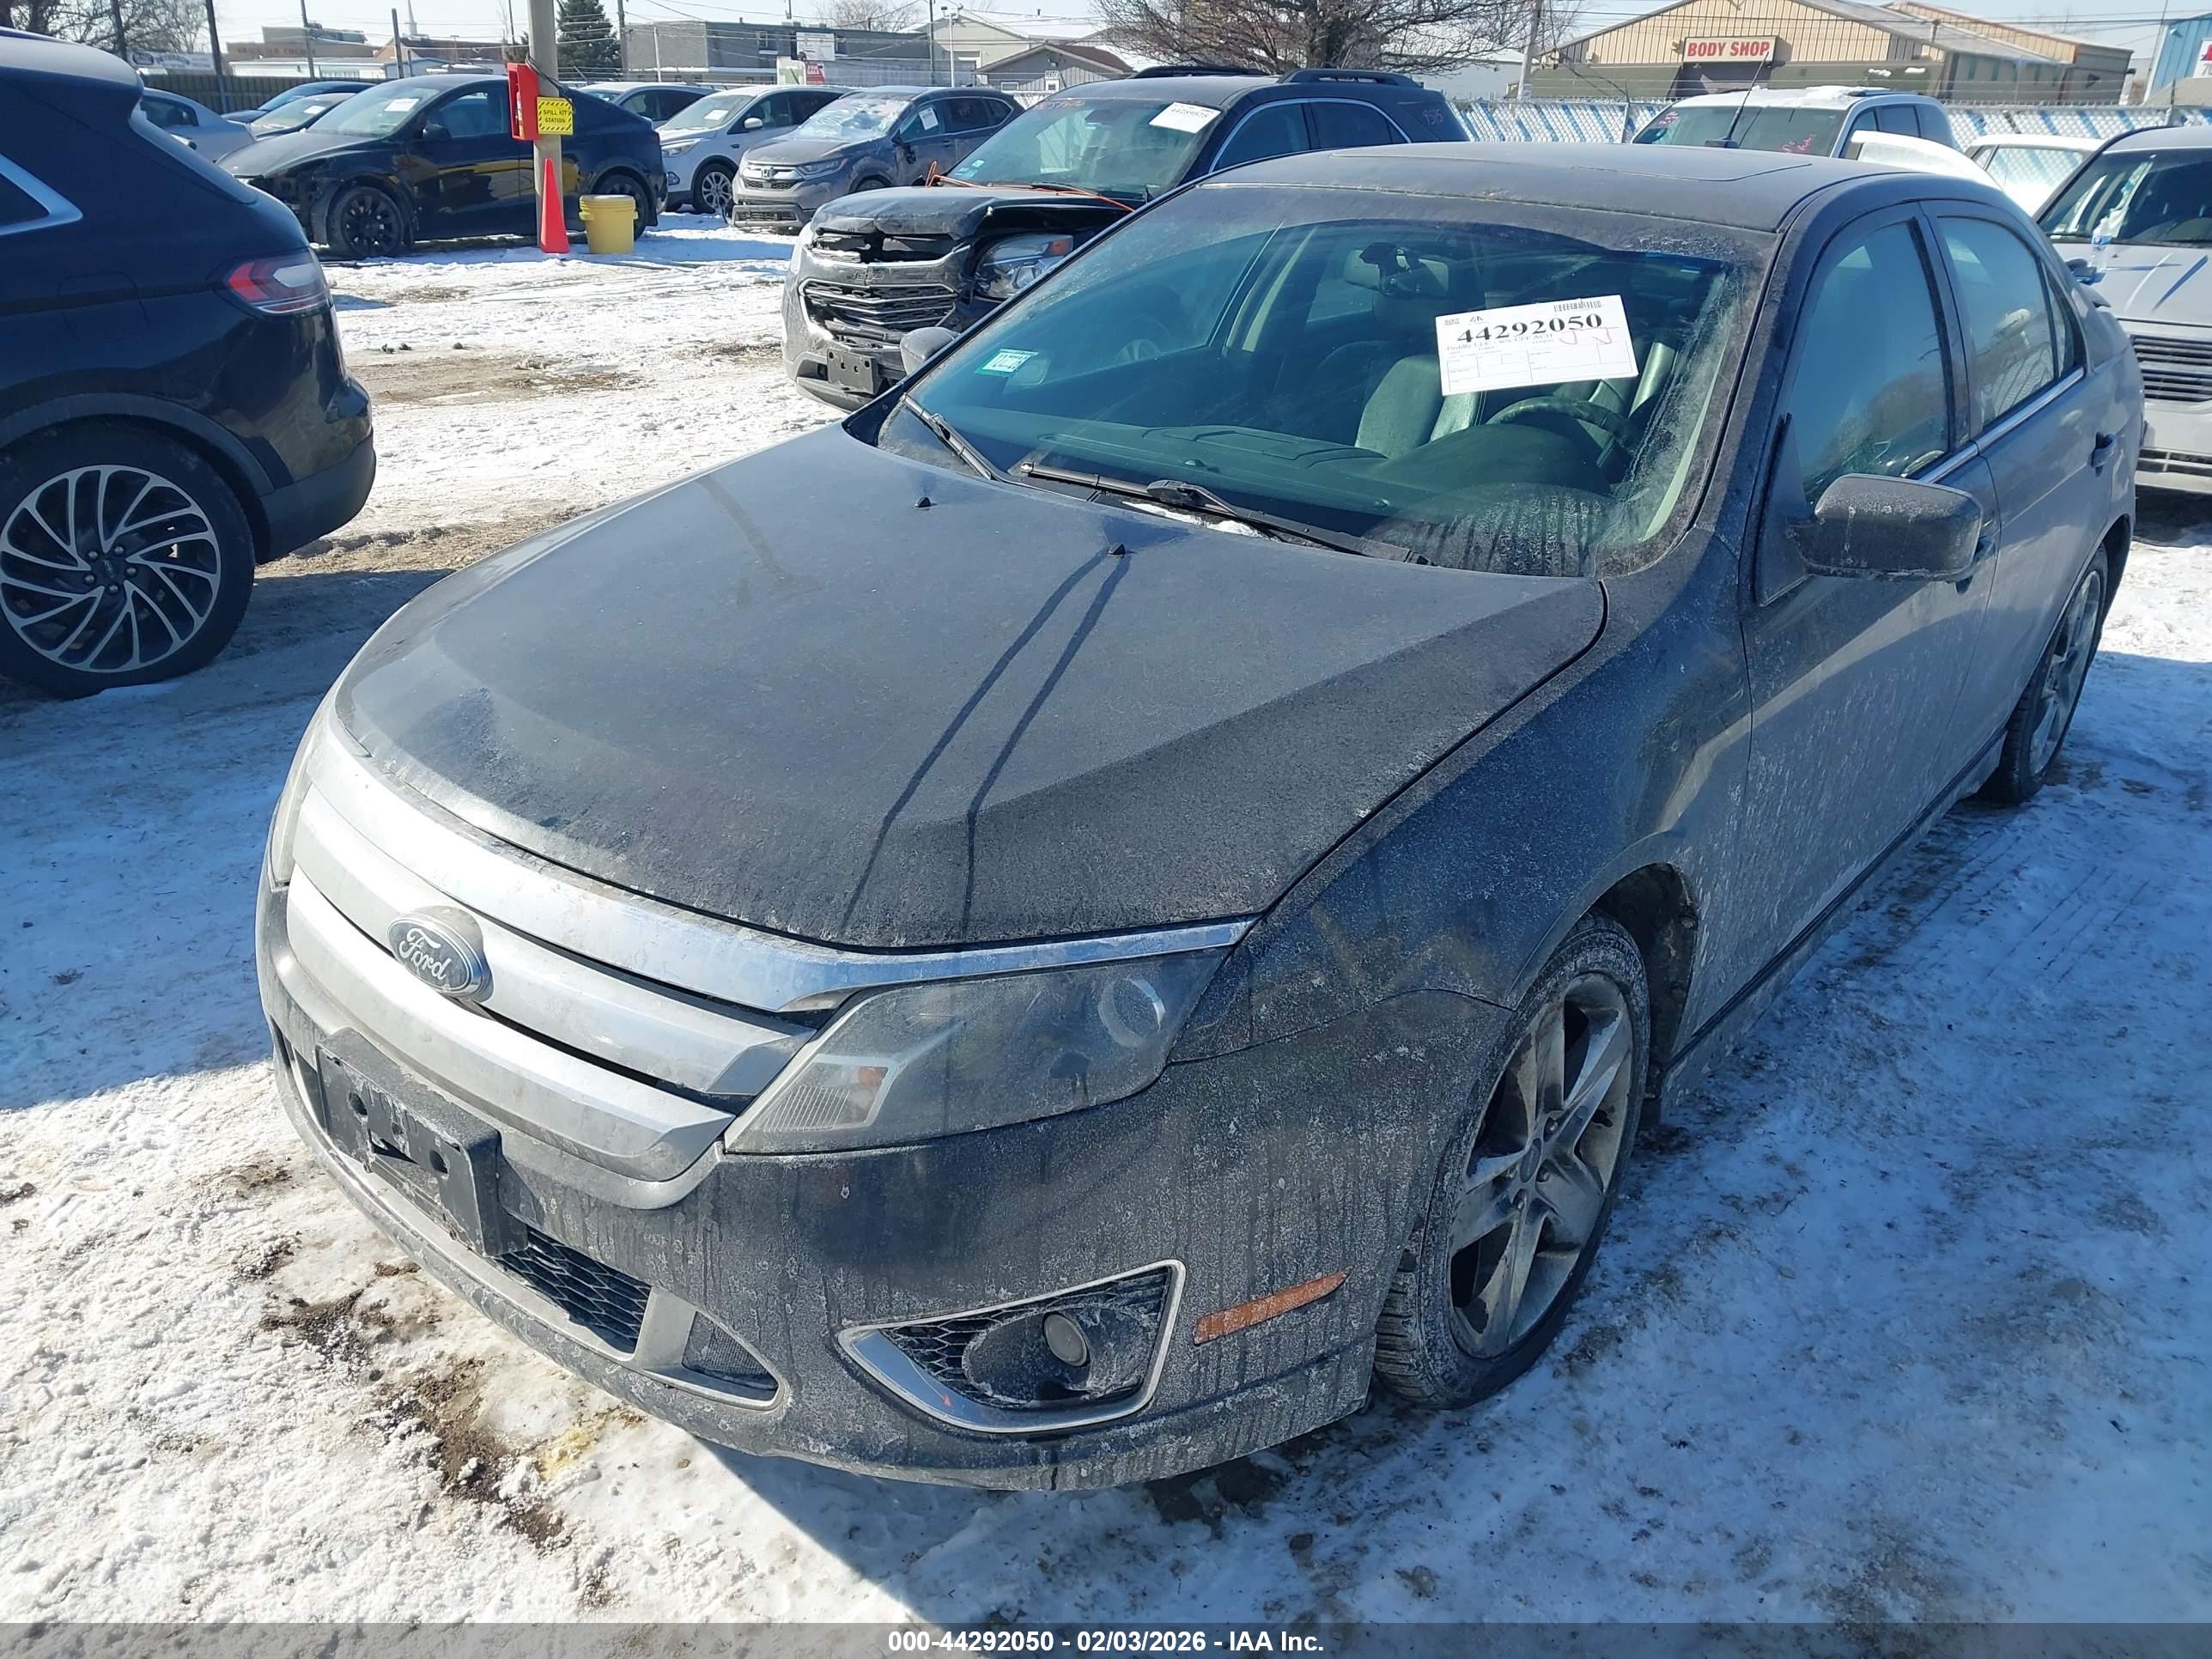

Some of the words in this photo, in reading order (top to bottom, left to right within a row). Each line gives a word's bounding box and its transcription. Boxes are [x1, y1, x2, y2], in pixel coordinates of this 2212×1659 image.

[1687, 41, 1726, 57] BODY
[1729, 40, 1771, 57] SHOP
[1456, 313, 1602, 343] 44292050
[398, 927, 452, 981] Ford
